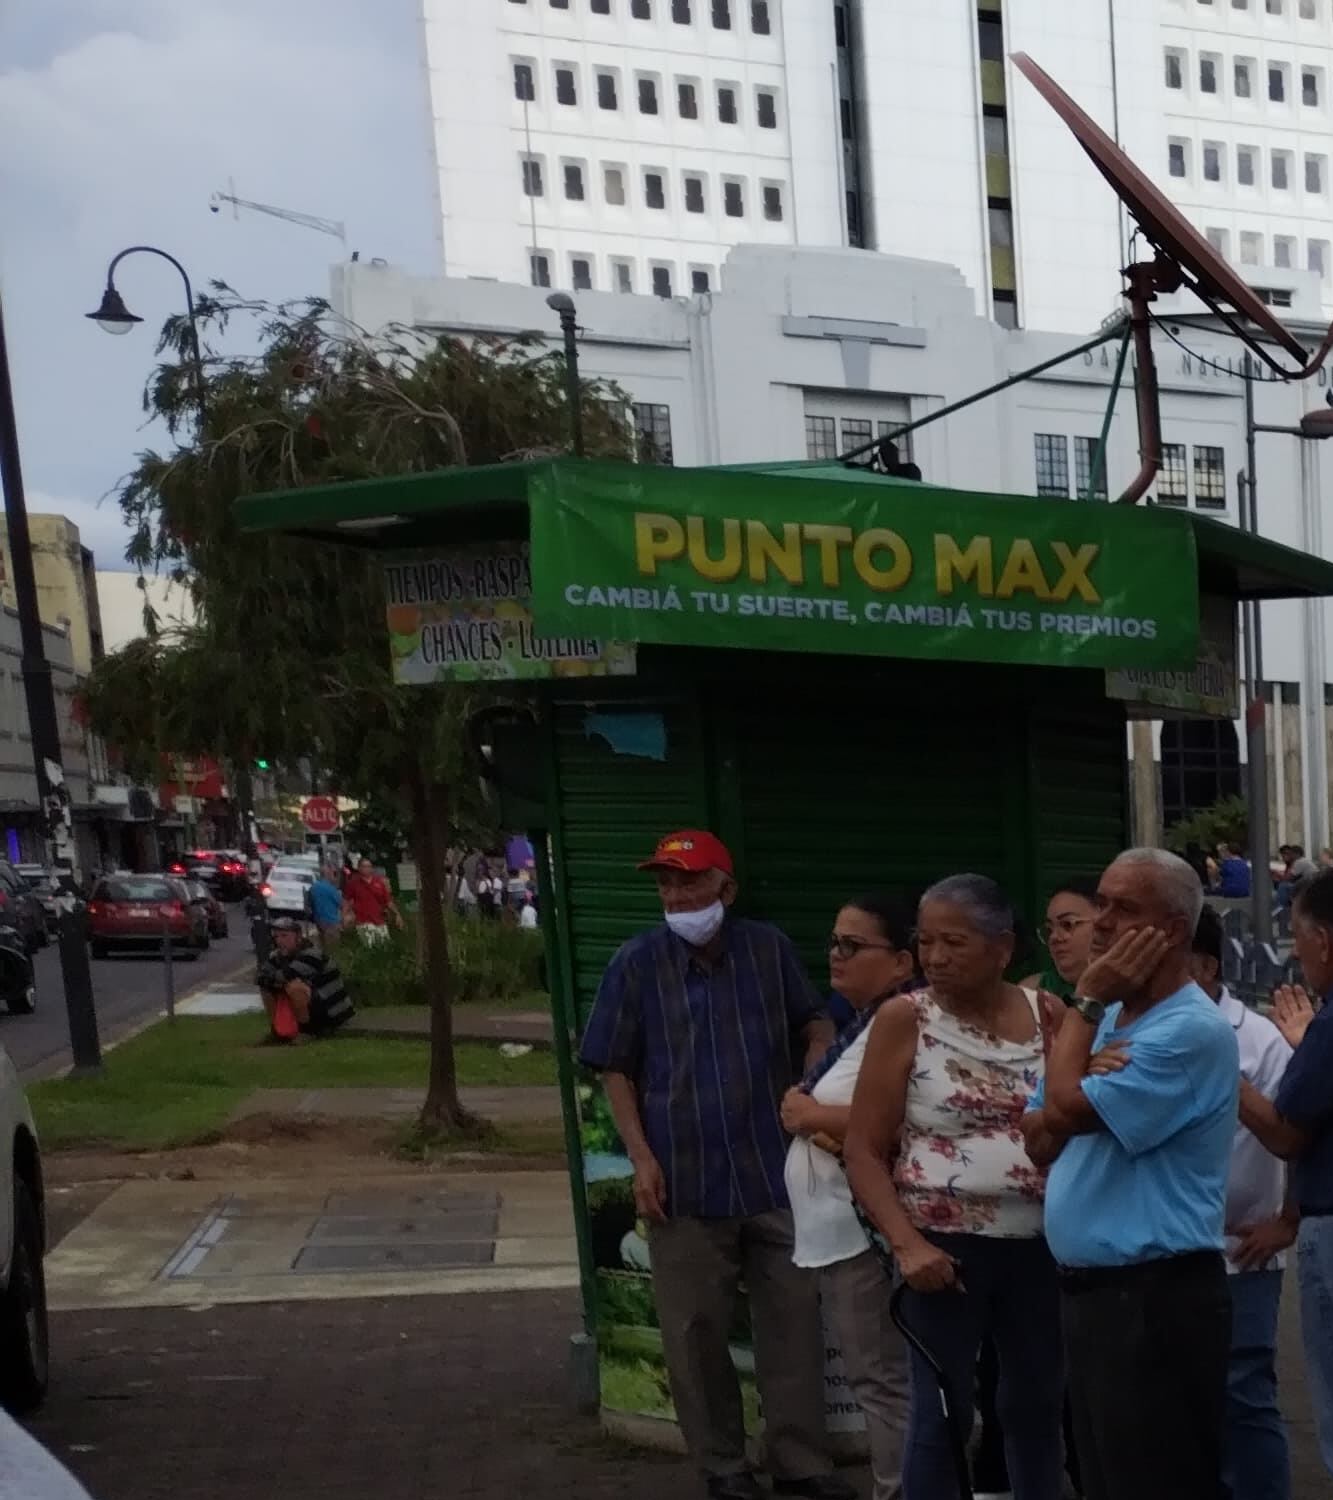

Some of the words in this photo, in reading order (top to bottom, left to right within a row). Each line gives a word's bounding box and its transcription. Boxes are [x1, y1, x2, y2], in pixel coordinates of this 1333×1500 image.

[1182, 352, 1289, 380] NACINA
[634, 511, 913, 593] PUNTO
[933, 533, 1104, 604] MAX
[387, 561, 463, 603] TIEMPOS
[564, 583, 683, 612] CAMBIÁ
[690, 591, 730, 614] TU
[737, 594, 857, 625] SUERTE,
[865, 601, 974, 628] CAMBIÁ
[980, 608, 1033, 632] TUS
[1040, 613, 1158, 640] PREMIOS
[421, 620, 502, 664] CHANCES
[304, 807, 337, 822] ALTO
